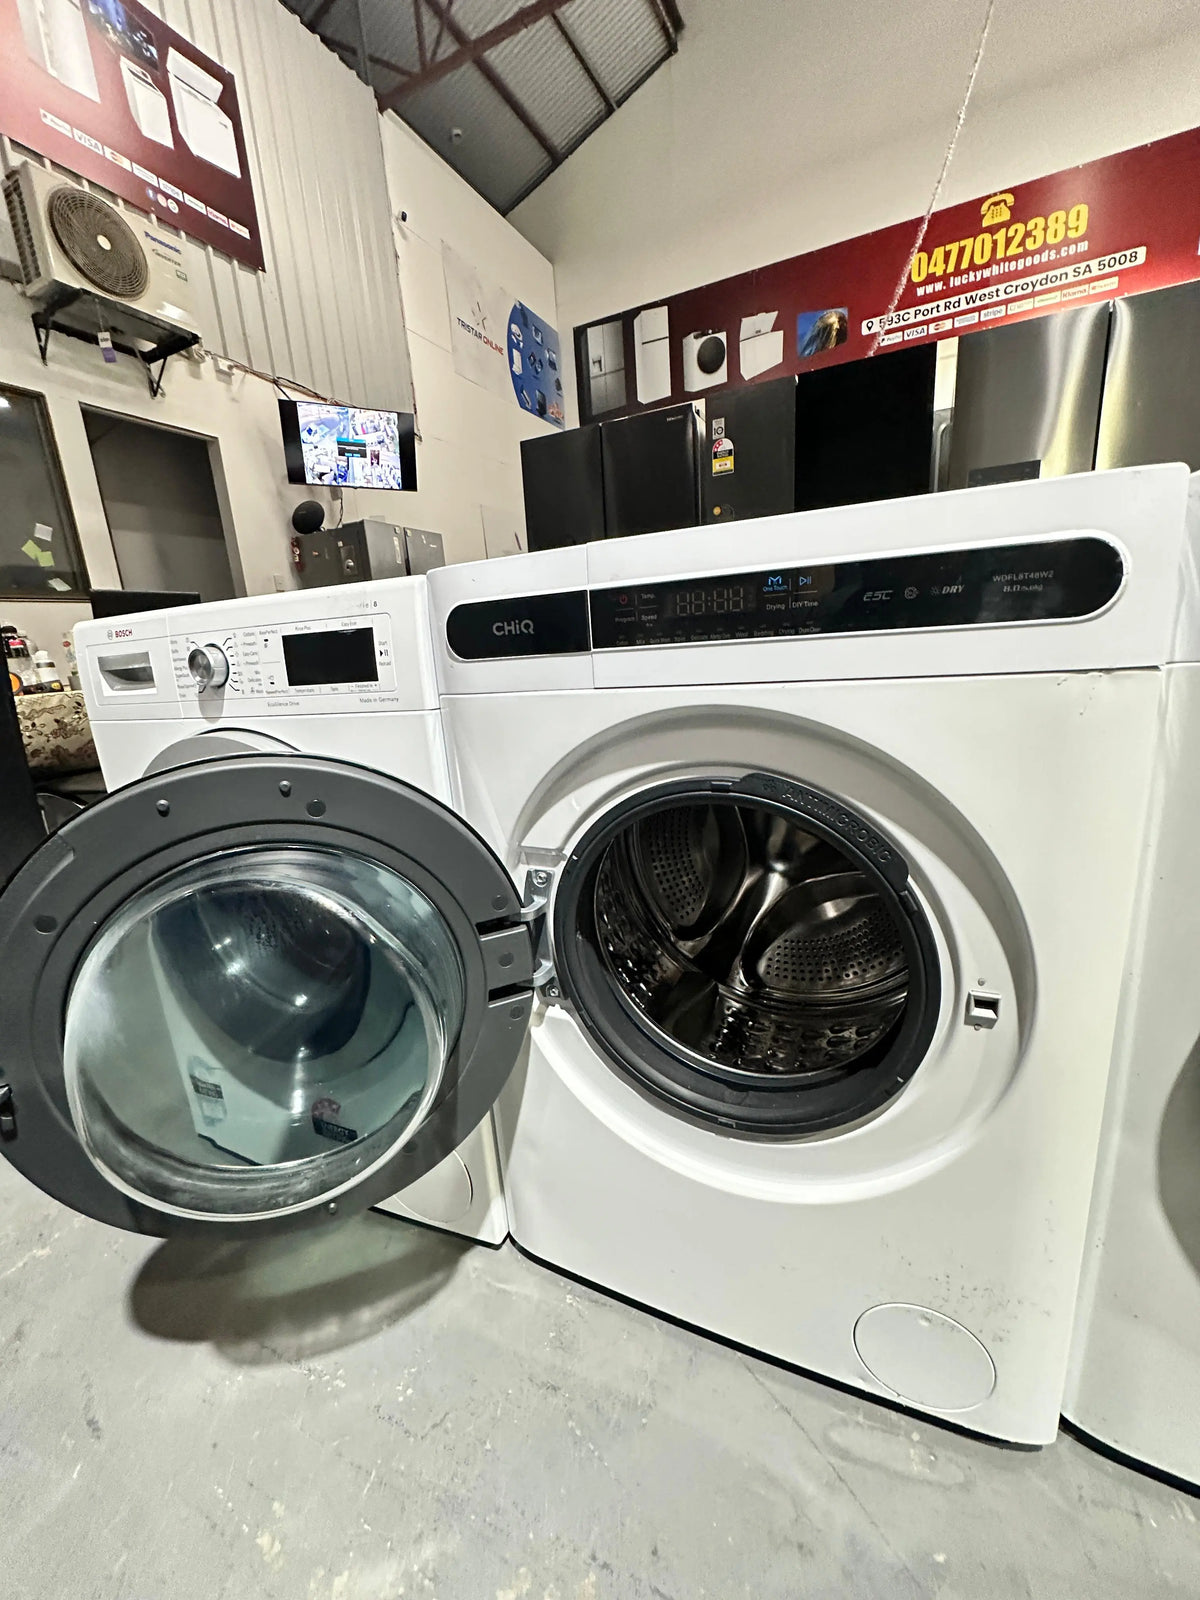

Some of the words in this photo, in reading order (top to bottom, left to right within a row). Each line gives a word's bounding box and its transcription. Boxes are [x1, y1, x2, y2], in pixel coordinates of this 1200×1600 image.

[76, 131, 100, 152] VISA
[144, 231, 181, 255] Panasonic
[911, 203, 1089, 283] 0477012389
[916, 280, 946, 297] www.
[950, 240, 1089, 288] luckywhitegoods.com
[878, 312, 911, 330] 593C
[914, 305, 941, 320] Port
[944, 298, 961, 312] Rd
[965, 287, 1001, 306] West
[1003, 270, 1069, 296] Croydon
[1072, 263, 1093, 278] SA
[1097, 250, 1138, 271] 5008
[1062, 288, 1087, 299] Klarna
[983, 308, 1003, 319] stripe
[457, 317, 482, 341] TRISTAR
[483, 336, 504, 356] ONLINE
[906, 327, 925, 338] VISA
[941, 585, 964, 595] DRY
[766, 603, 785, 611] Drying
[641, 614, 657, 622] Speed
[115, 629, 132, 638] BOSCH
[492, 619, 534, 636] CHiQ
